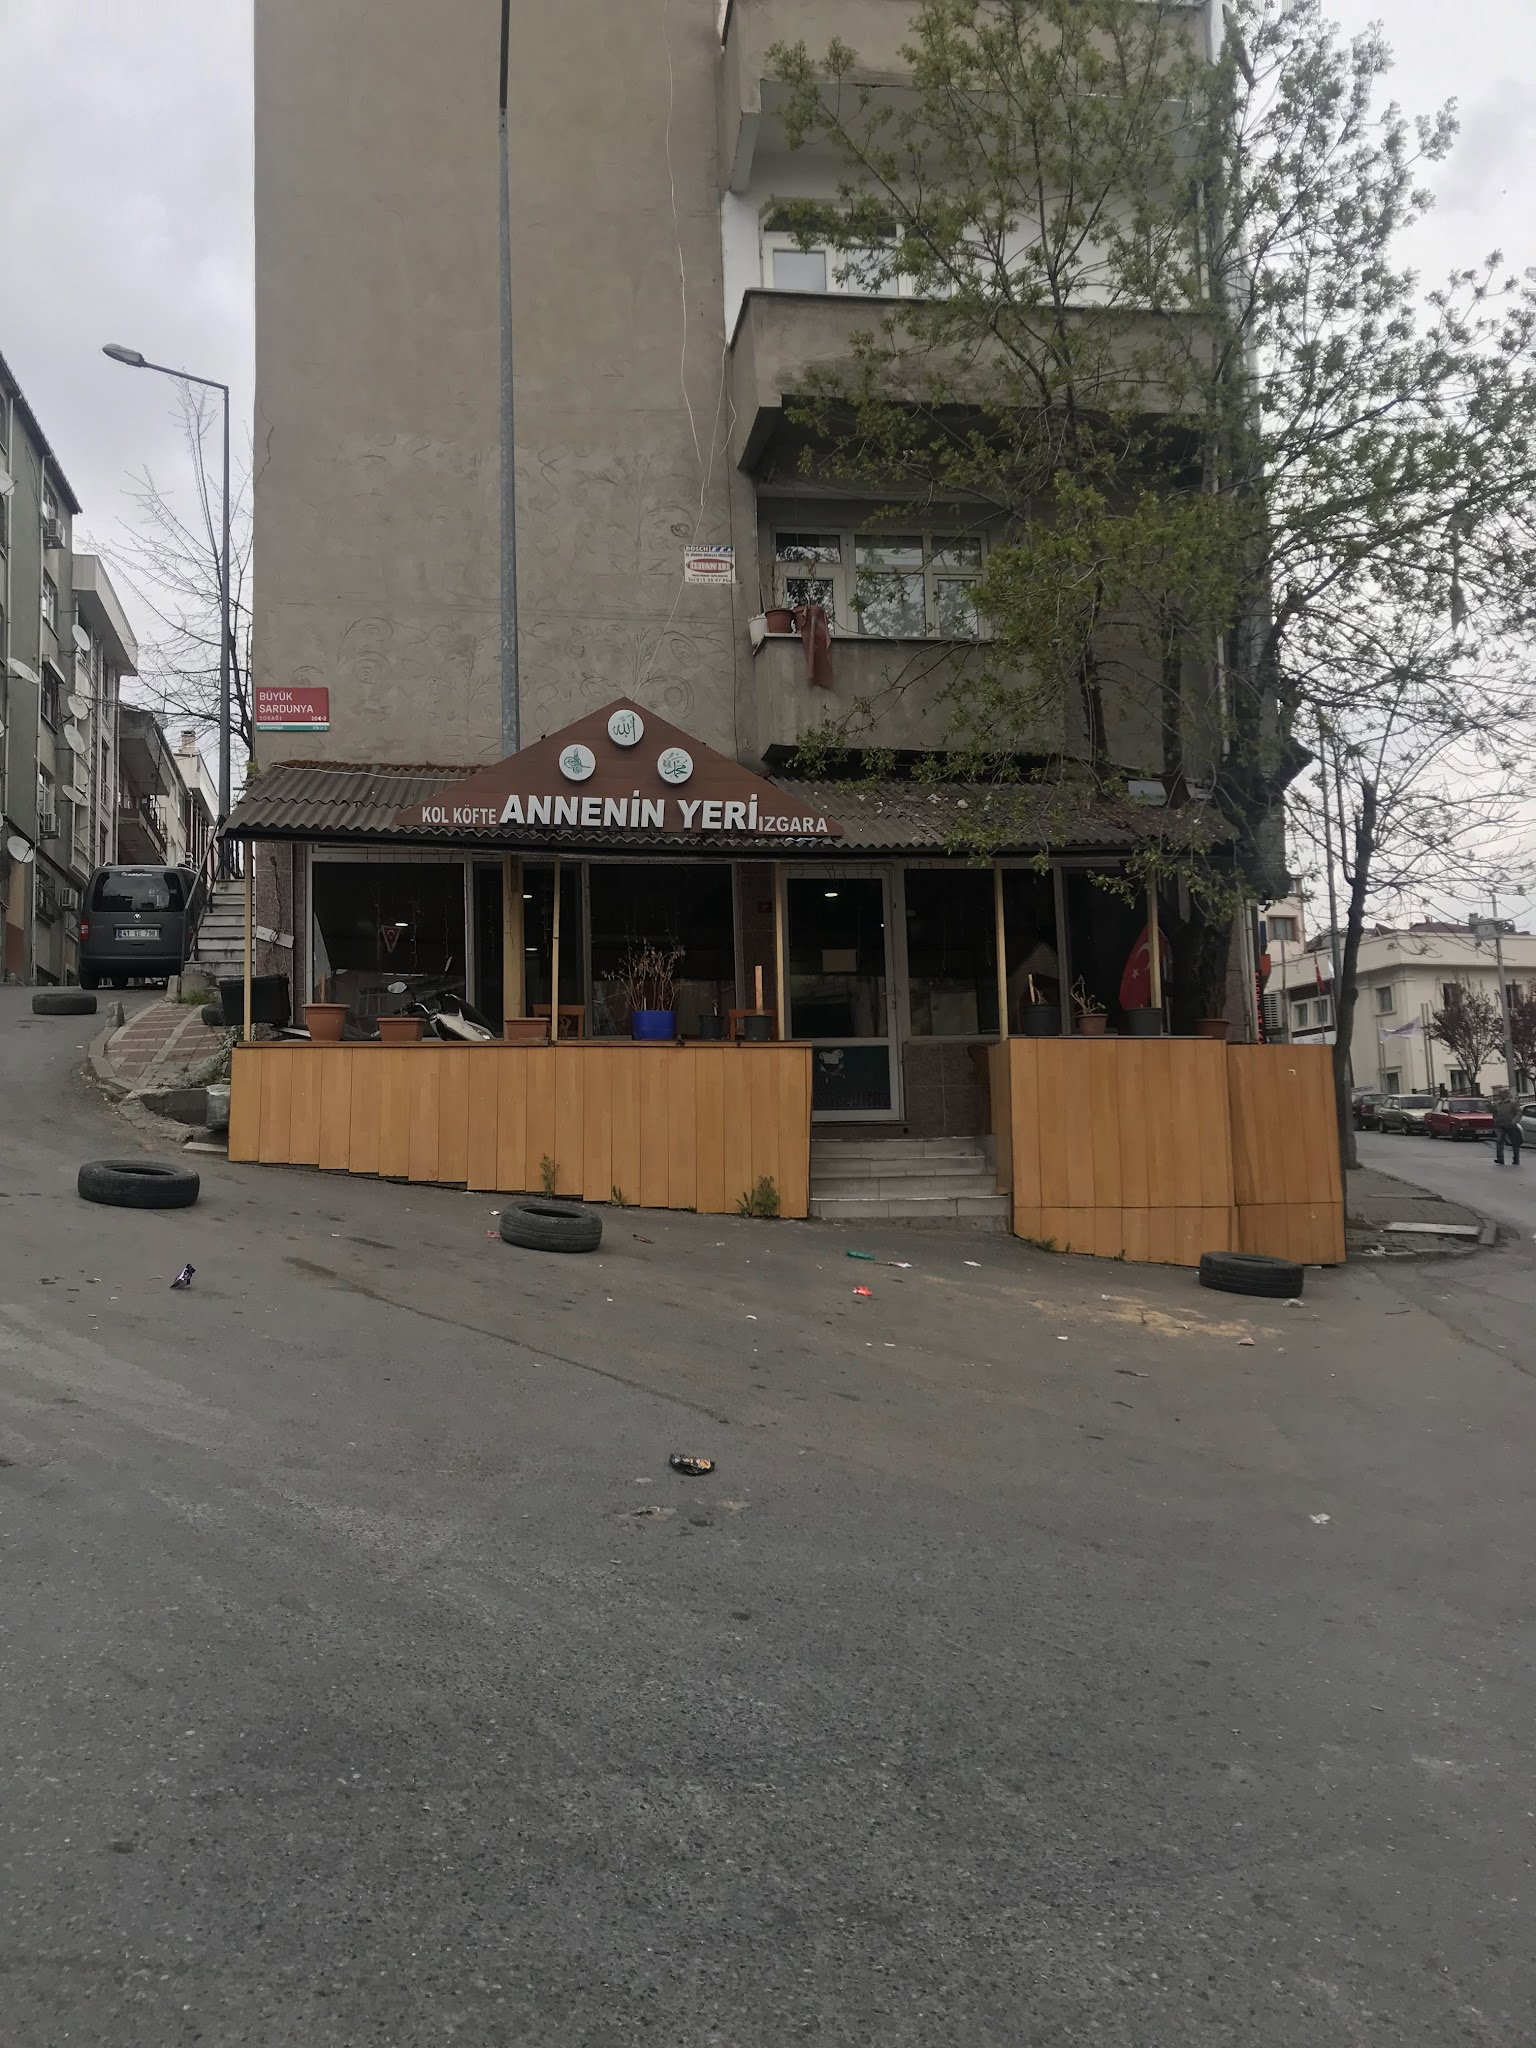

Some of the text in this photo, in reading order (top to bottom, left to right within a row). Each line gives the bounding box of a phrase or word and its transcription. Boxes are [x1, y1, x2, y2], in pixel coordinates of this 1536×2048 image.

[259, 690, 293, 701] BÜYÜK
[259, 704, 314, 713] SARDUNYA
[421, 790, 829, 834] KOL KÖFTE ANNENİN YERİ IZGARA
